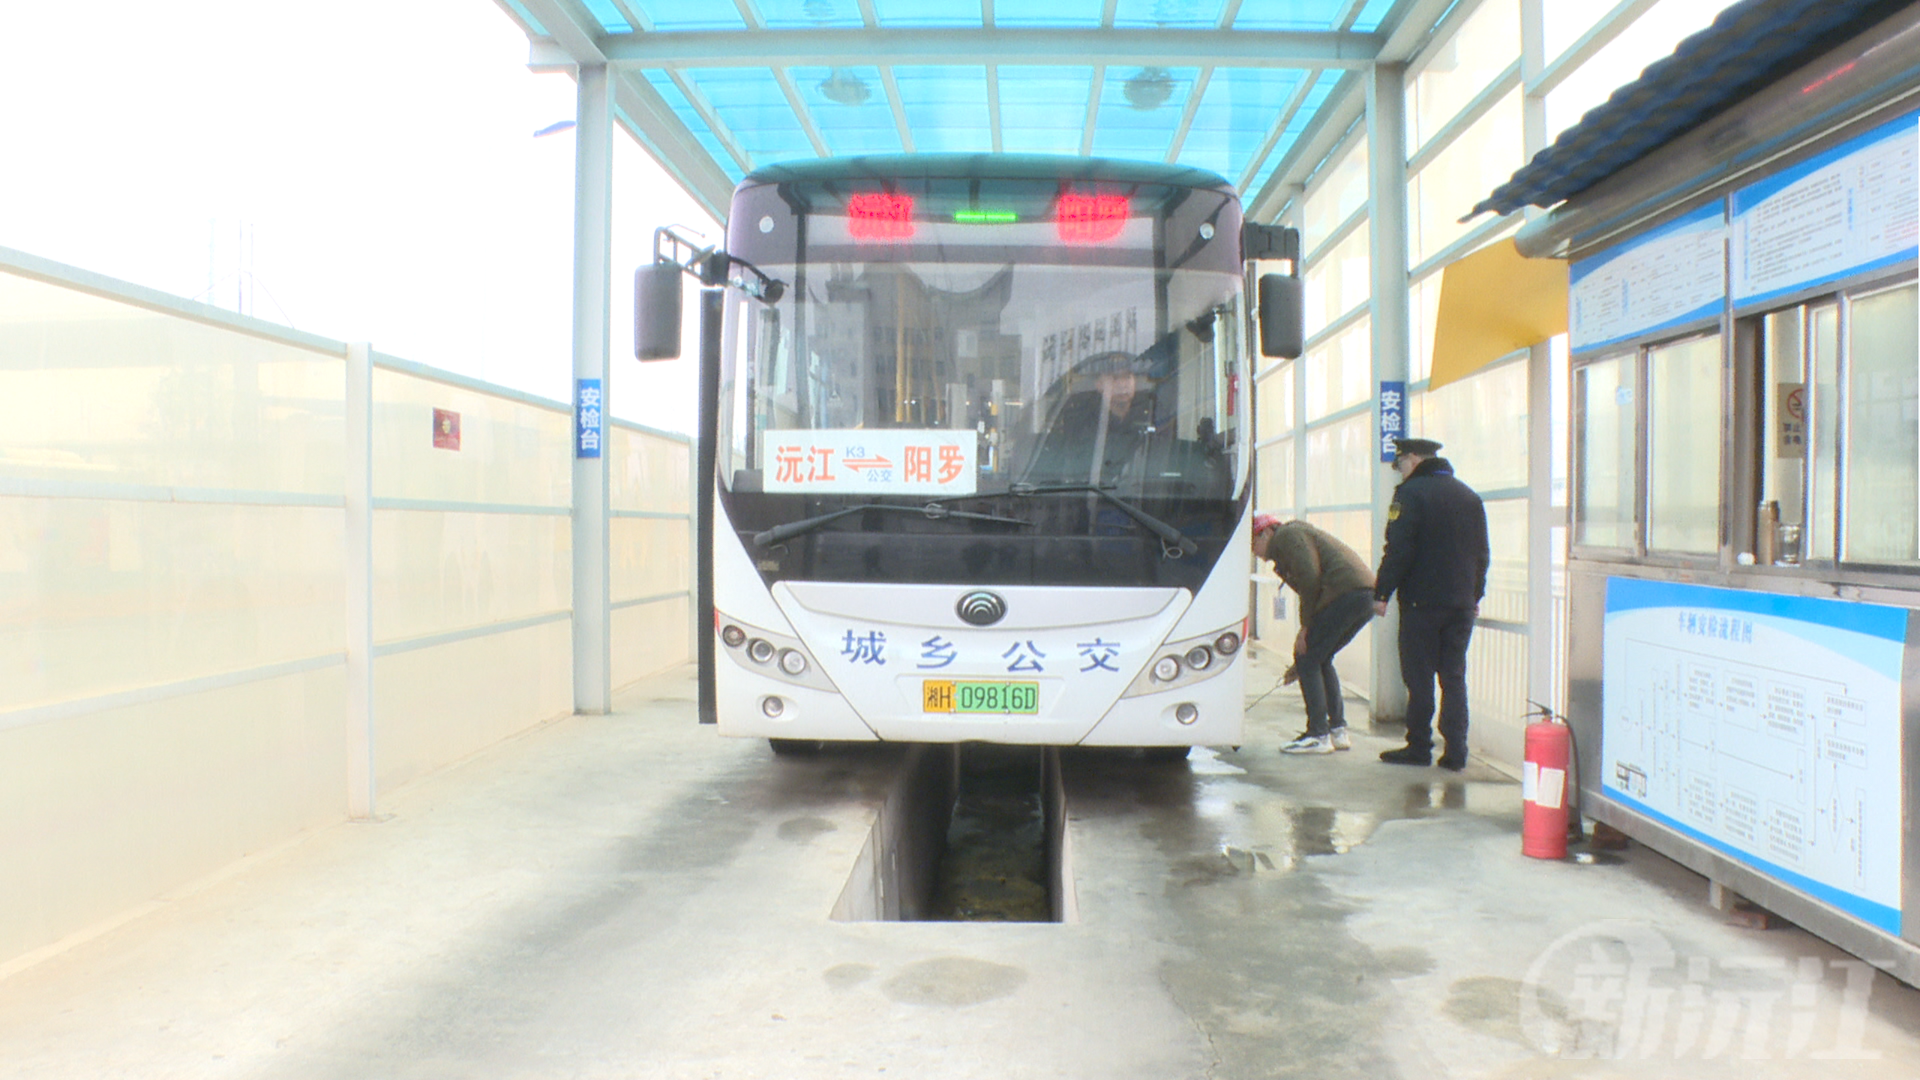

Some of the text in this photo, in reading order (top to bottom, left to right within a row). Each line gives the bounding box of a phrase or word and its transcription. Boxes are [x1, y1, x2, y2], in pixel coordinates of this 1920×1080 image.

[580, 387, 600, 451] 安检台
[1381, 390, 1401, 454] 安检台
[775, 445, 836, 483] 沅江
[845, 446, 866, 458] K3
[903, 445, 965, 484] 阳罗
[866, 469, 893, 482] 公交
[840, 629, 1121, 673] 城乡公交
[926, 685, 1037, 710] 湘H 09816D
